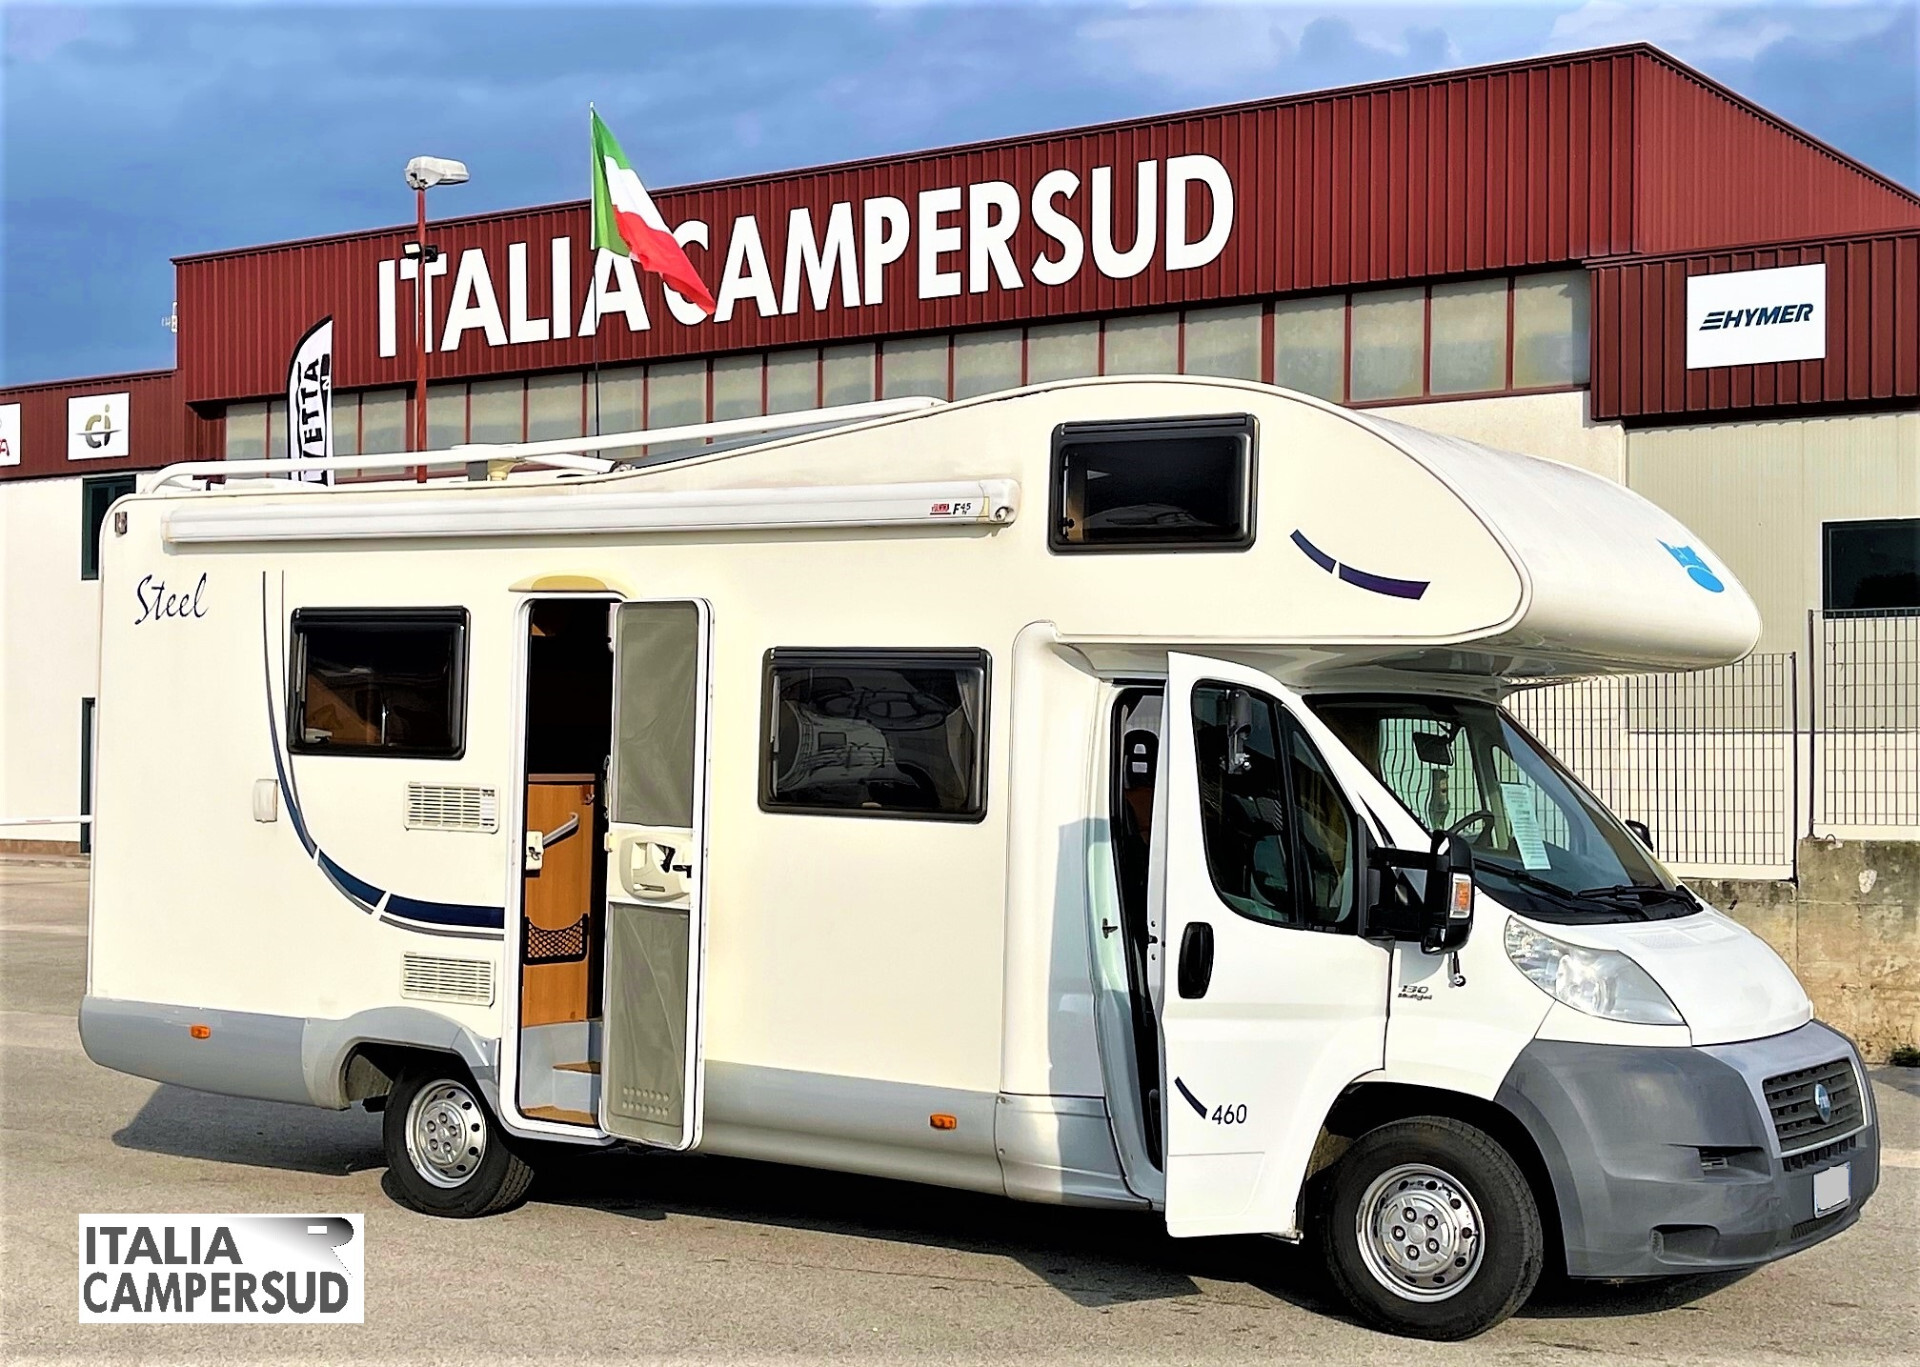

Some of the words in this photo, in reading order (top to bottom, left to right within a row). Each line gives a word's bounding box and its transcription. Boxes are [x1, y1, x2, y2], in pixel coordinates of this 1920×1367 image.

[378, 236, 651, 358] ITALIA
[662, 154, 1235, 326] CAMPERSUD
[1723, 303, 1814, 329] HYMER
[135, 572, 209, 625] Steel
[1212, 1104, 1247, 1125] 460
